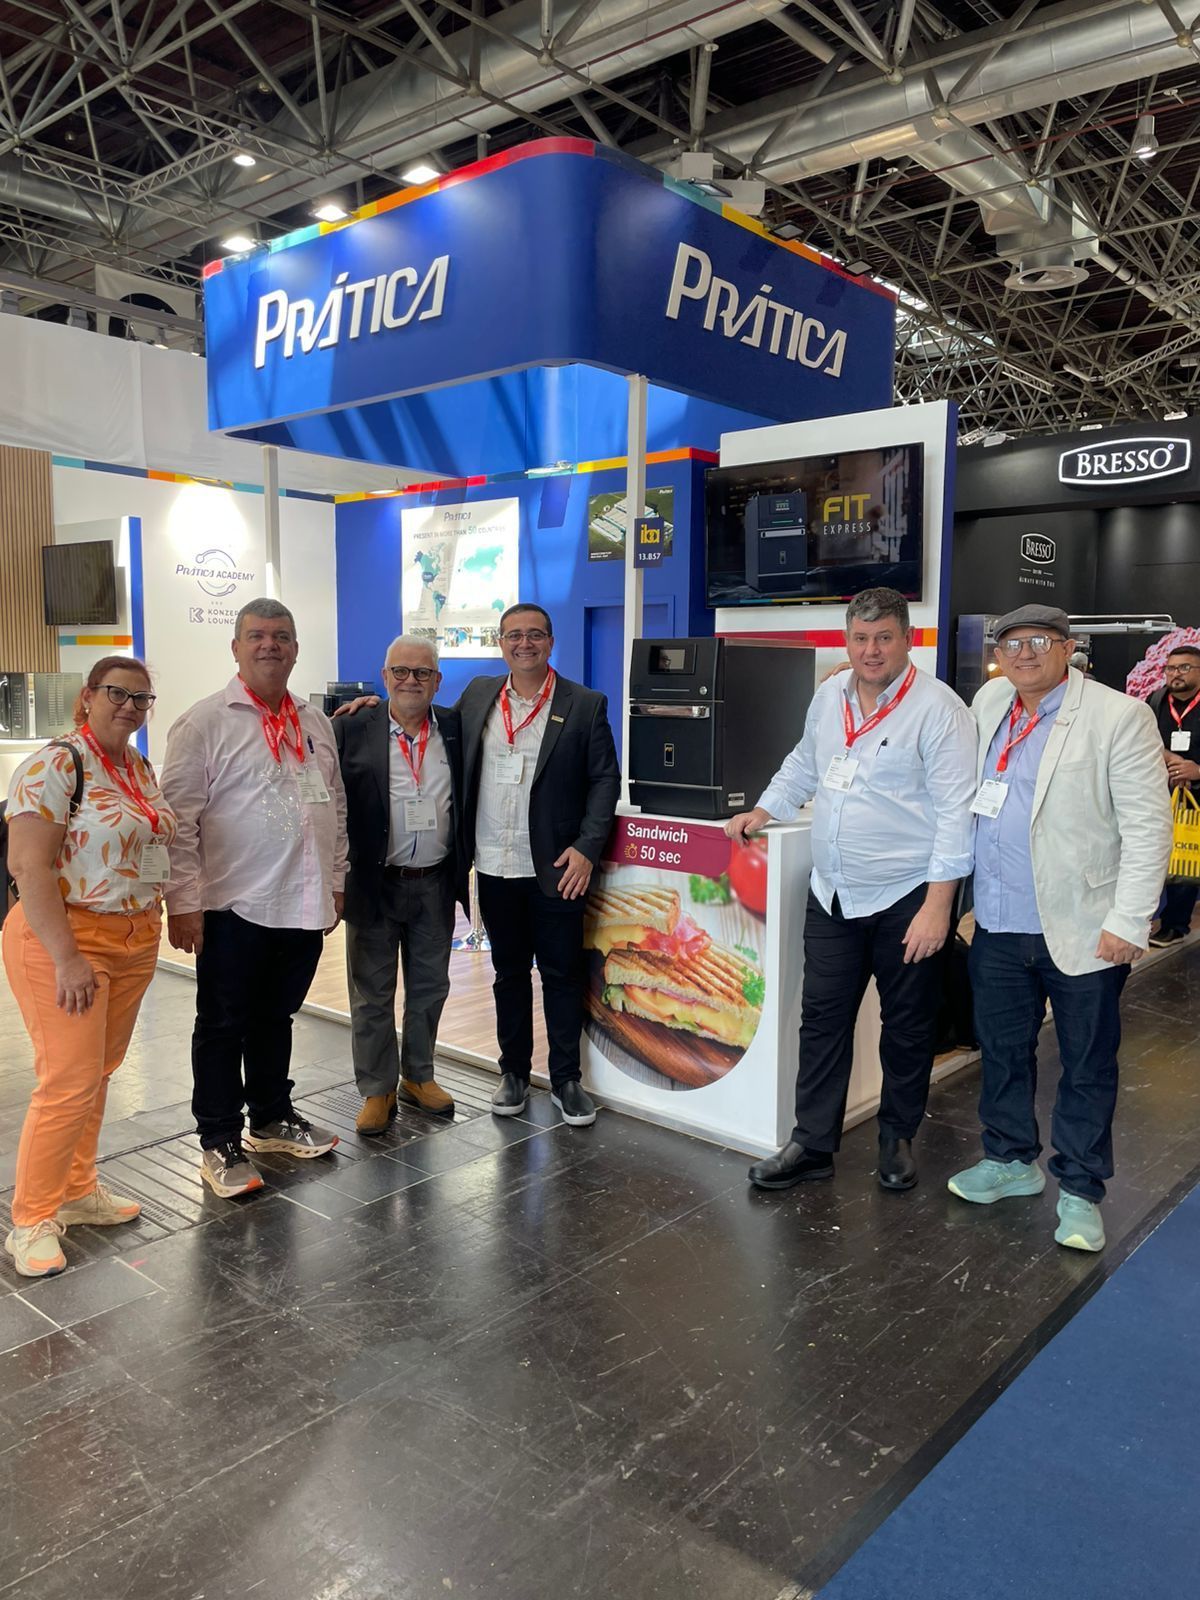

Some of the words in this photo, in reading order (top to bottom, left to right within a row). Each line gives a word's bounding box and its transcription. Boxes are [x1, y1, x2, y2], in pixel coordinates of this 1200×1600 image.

[1076, 447, 1171, 477] BRESSO
[823, 493, 871, 523] FIT
[468, 525, 477, 535] 50
[823, 521, 871, 535] EXPRESS
[216, 570, 255, 581] ACADEMY
[207, 608, 240, 617] KONZEP
[207, 617, 236, 625] LOUNG
[627, 822, 689, 844] Sandwich
[1174, 841, 1199, 851] CKER
[640, 845, 656, 861] 50
[659, 850, 681, 865] sec
